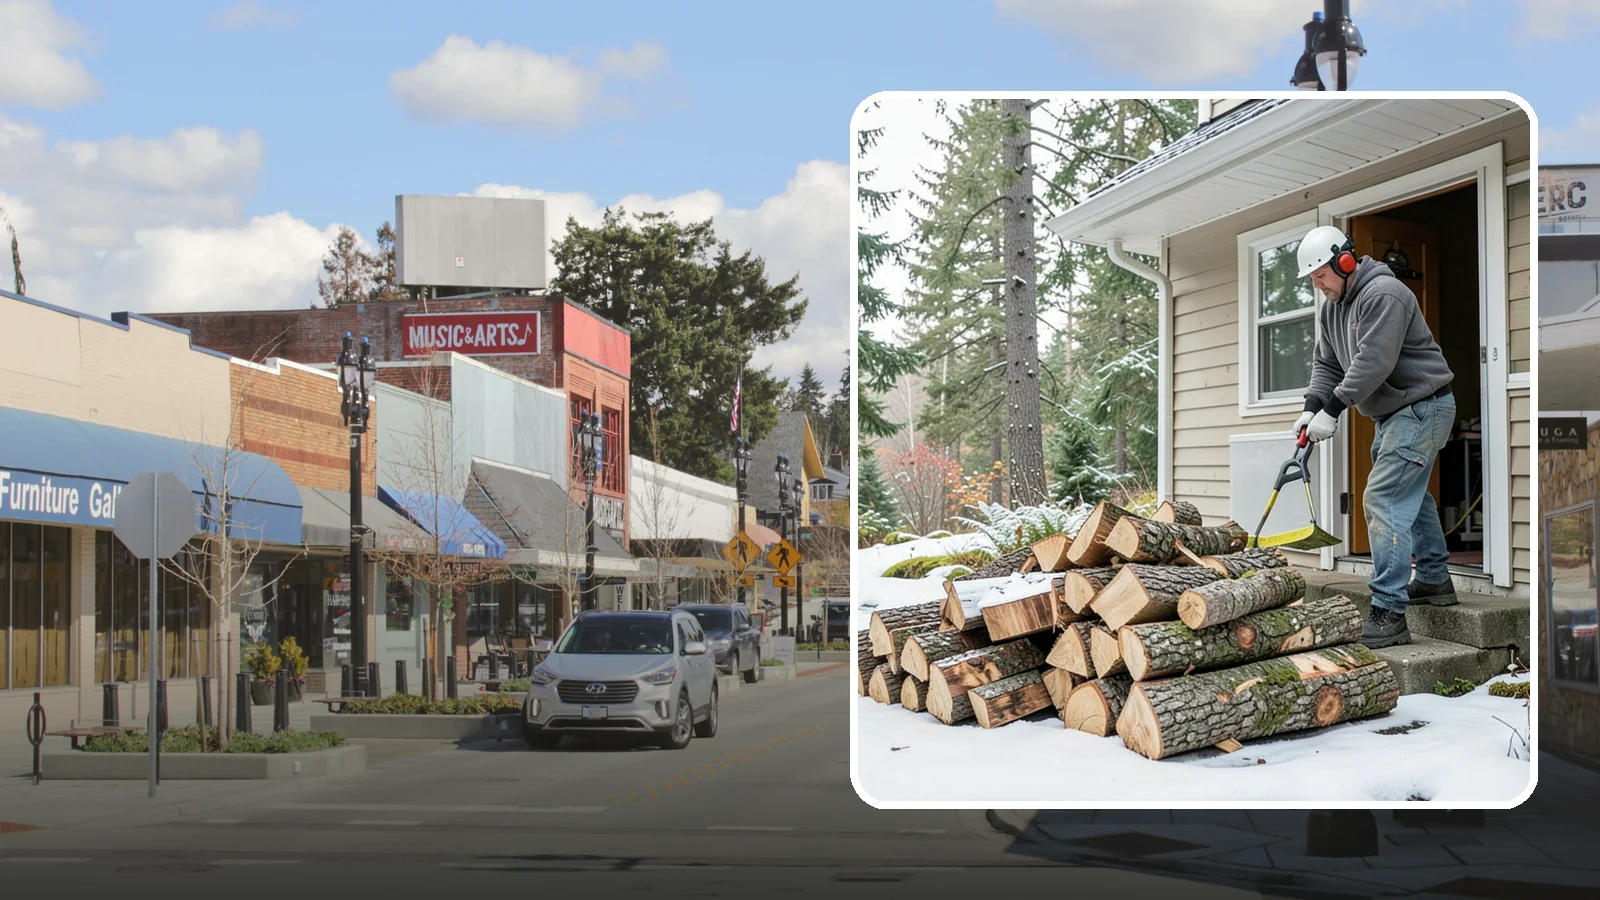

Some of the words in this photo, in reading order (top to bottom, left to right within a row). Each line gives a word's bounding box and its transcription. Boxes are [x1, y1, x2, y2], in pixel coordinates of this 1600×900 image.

[1540, 427, 1577, 437] UGA
[0, 471, 79, 515] Furniture
[89, 482, 122, 519] Gal
